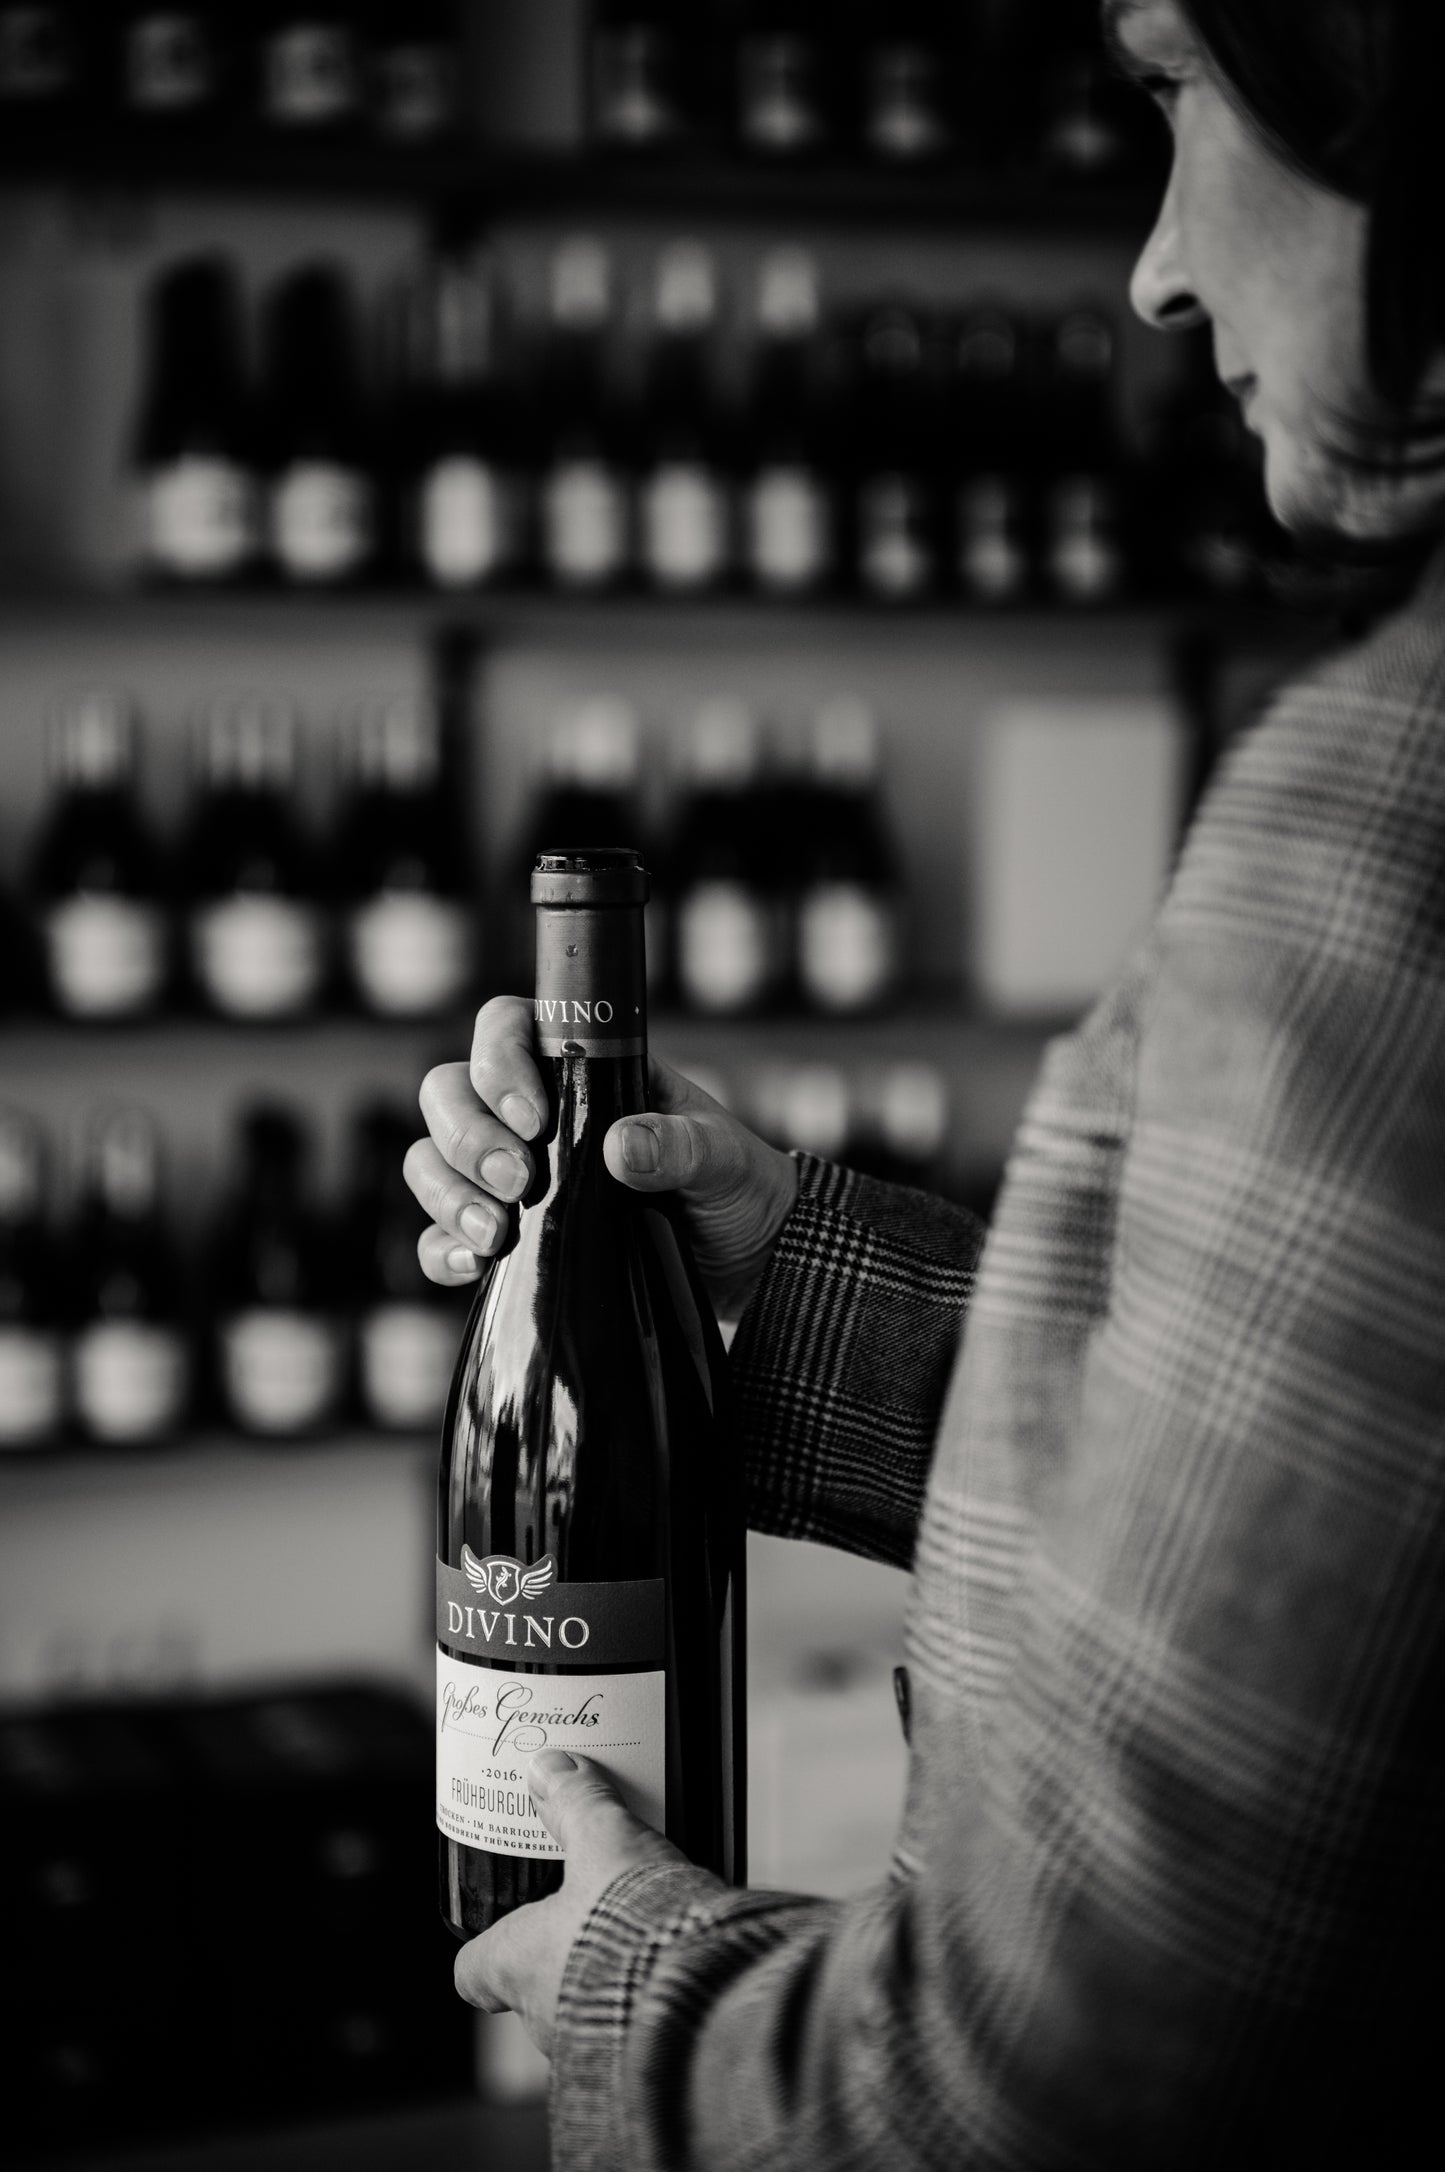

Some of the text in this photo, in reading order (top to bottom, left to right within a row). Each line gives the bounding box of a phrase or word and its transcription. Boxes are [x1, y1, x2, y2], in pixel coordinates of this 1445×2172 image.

[447, 1601, 590, 1649] DIVINO
[441, 1681, 604, 1757] Großes Gewächs
[473, 1819, 484, 1830] IM
[488, 1824, 548, 1839] BARRIQUE
[484, 1835, 565, 1853] THÜNGERSHEI
